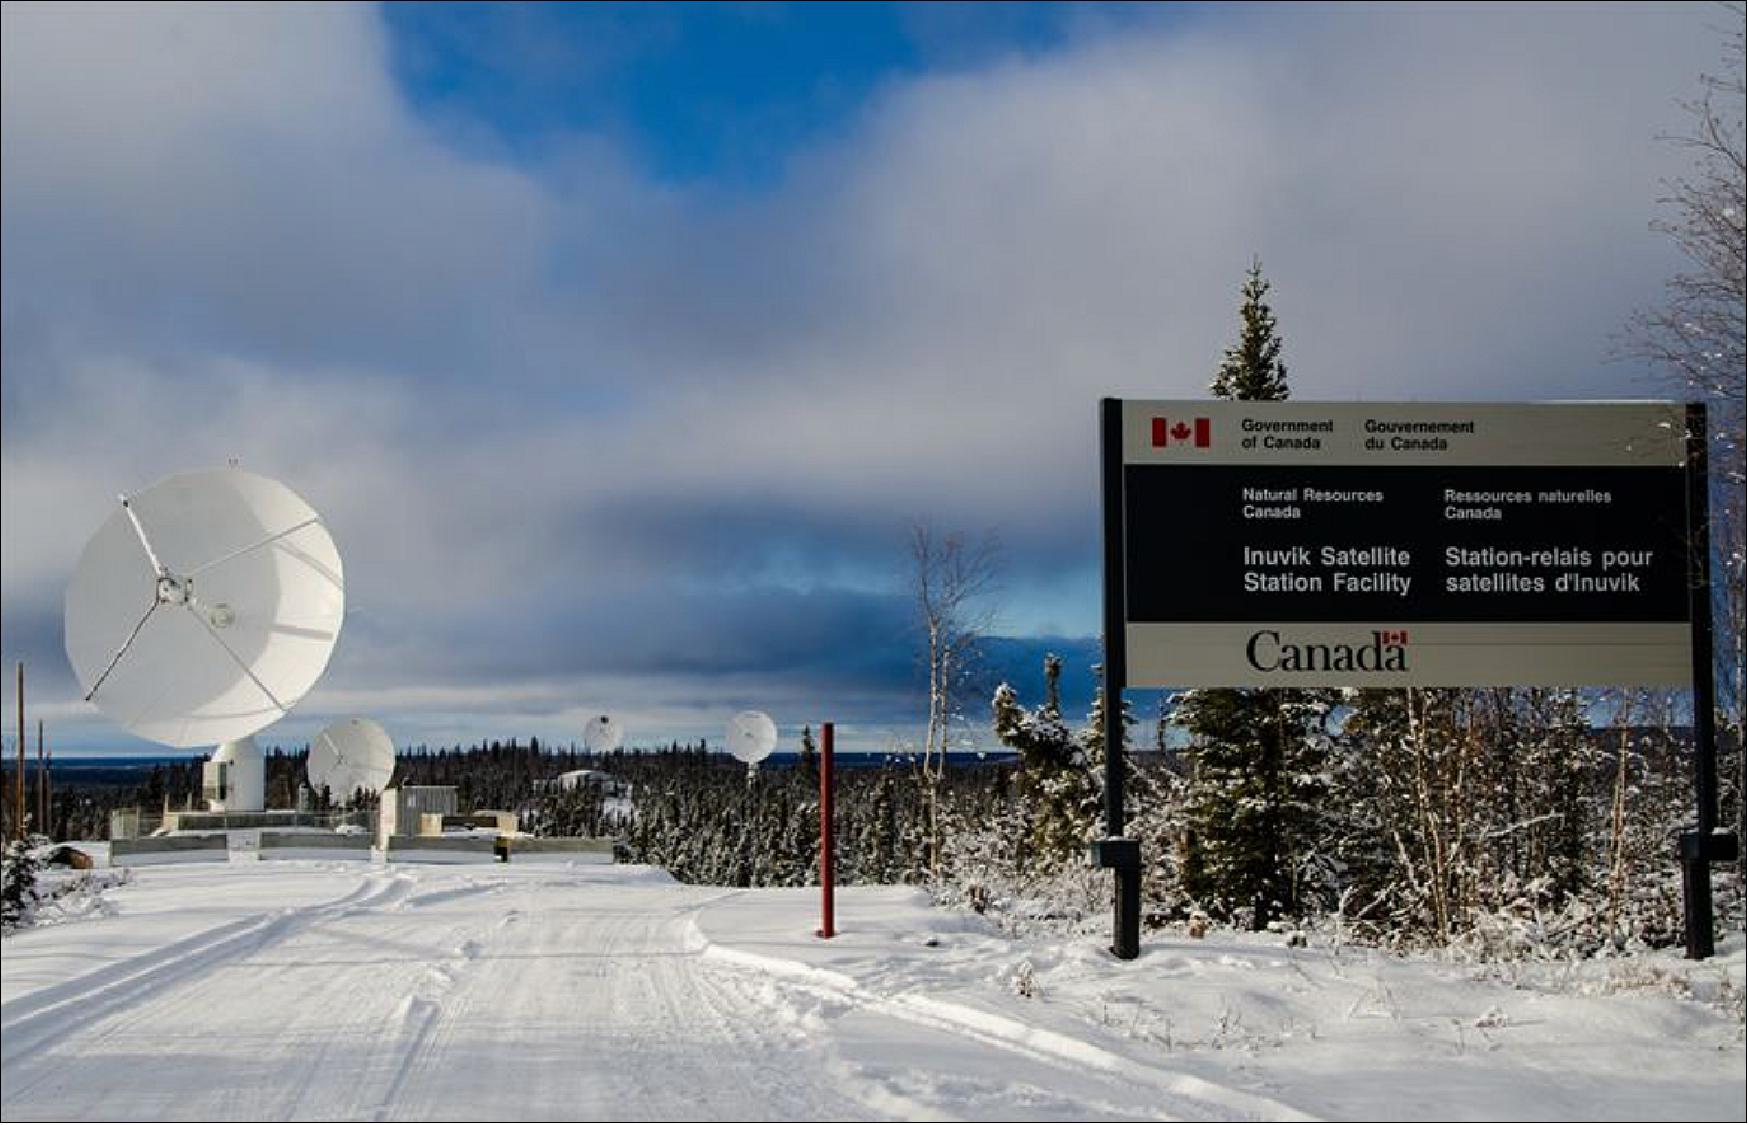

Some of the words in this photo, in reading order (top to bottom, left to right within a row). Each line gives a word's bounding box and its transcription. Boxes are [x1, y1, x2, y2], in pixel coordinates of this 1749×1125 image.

[1241, 418, 1334, 433] Government
[1364, 418, 1475, 434] Gouvernement
[1241, 435, 1257, 449] of
[1263, 436, 1321, 450] Canada
[1365, 436, 1385, 451] du
[1390, 436, 1448, 451] Canada
[1243, 487, 1298, 501] Natural
[1302, 487, 1385, 503] Resources
[1444, 488, 1533, 504] Ressources
[1538, 489, 1612, 504] naturelles
[1243, 503, 1301, 519] Canada
[1444, 505, 1503, 520] Canada
[1244, 545, 1312, 566] Inuvik
[1320, 545, 1411, 566] Satellite
[1445, 545, 1592, 568] Station-relais
[1601, 550, 1654, 572] pour
[1244, 571, 1322, 592] Station
[1333, 572, 1412, 597] Facility
[1445, 572, 1546, 593] satellites
[1554, 572, 1640, 592] d'Inuvik
[1246, 630, 1408, 672] Canada
